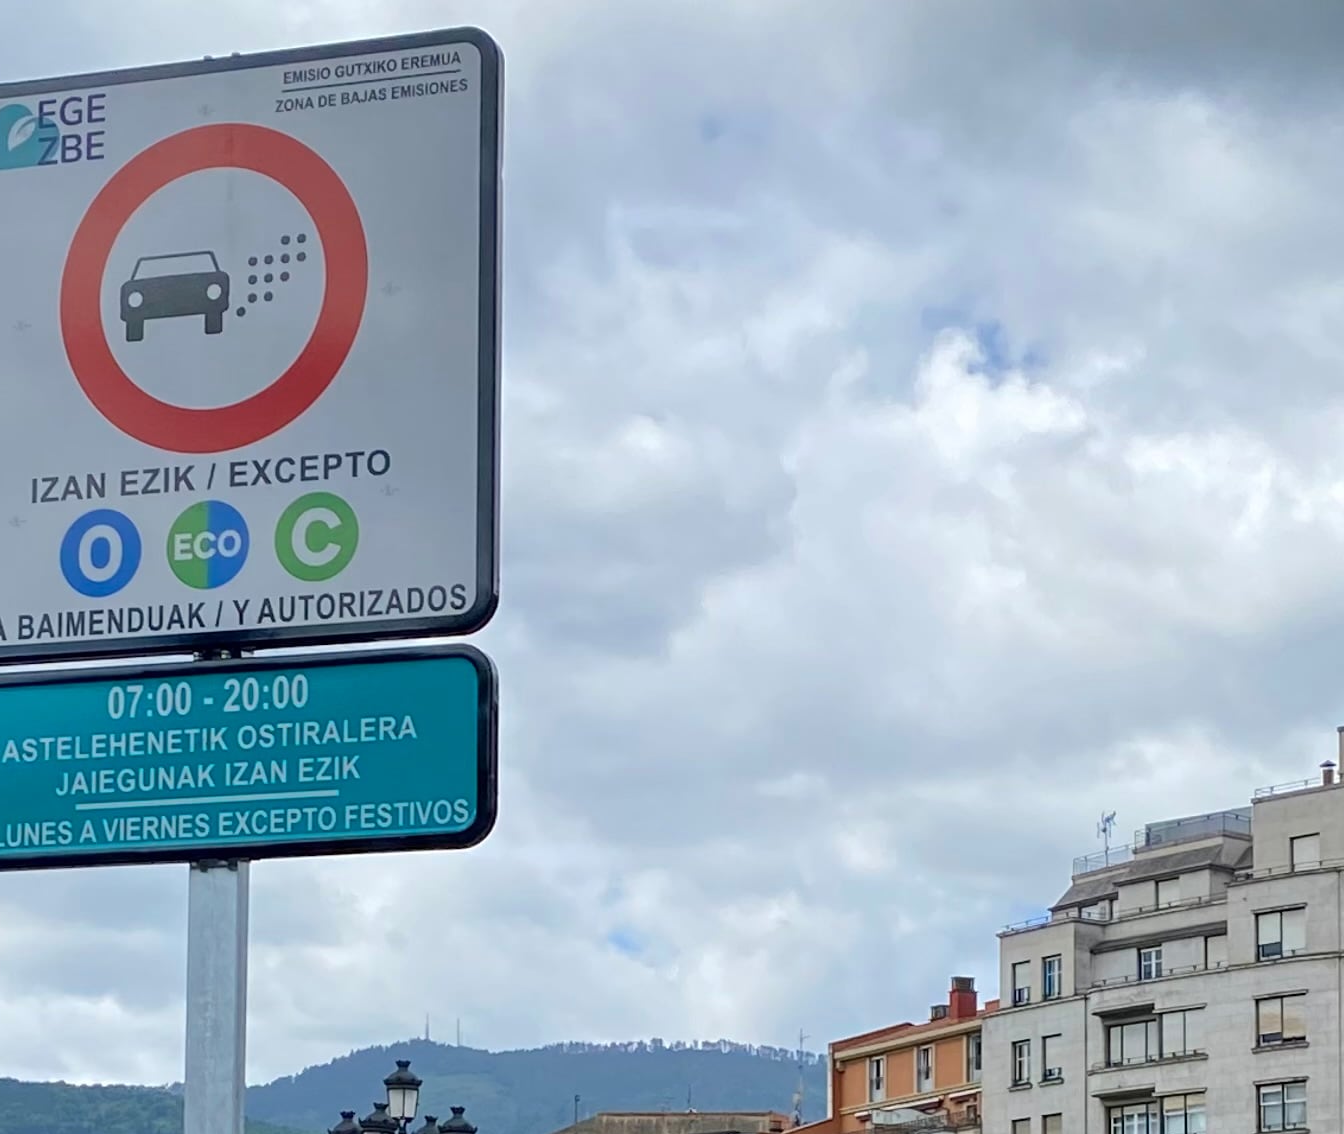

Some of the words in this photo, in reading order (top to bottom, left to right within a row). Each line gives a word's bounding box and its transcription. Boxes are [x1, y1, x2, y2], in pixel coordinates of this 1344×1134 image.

[283, 67, 331, 85] EMISIO
[334, 58, 397, 78] GUTXIKO
[401, 51, 461, 71] EREMUA
[38, 93, 106, 129] EGE
[275, 97, 314, 113] ZONA
[317, 93, 337, 108] DE
[341, 88, 387, 105] BAJAS
[391, 78, 468, 99] EMISIONES
[38, 131, 105, 165] ZBE
[31, 471, 106, 504] IZAN
[120, 465, 195, 496] EZIK
[207, 463, 216, 490] /
[229, 449, 391, 487] EXCEPTO
[173, 529, 242, 559] ECO
[291, 506, 342, 567] C
[17, 601, 206, 641] BAIMENDUAK
[215, 599, 224, 628] /
[233, 599, 251, 626] Y
[258, 584, 467, 625] AUTORIZADOS
[108, 682, 192, 719] 07:00
[223, 674, 309, 713] 20:00
[2, 726, 228, 763] ASTELEHENETIK
[237, 716, 417, 751] OSTIRALERA
[56, 763, 215, 797] JAIEGUNAK
[225, 758, 288, 785] IZAN
[298, 755, 360, 783] EZIK
[80, 818, 97, 845] A
[102, 812, 210, 844] VIERNES
[218, 805, 336, 836] EXCEPTO
[344, 799, 469, 832] FESTIVOS
